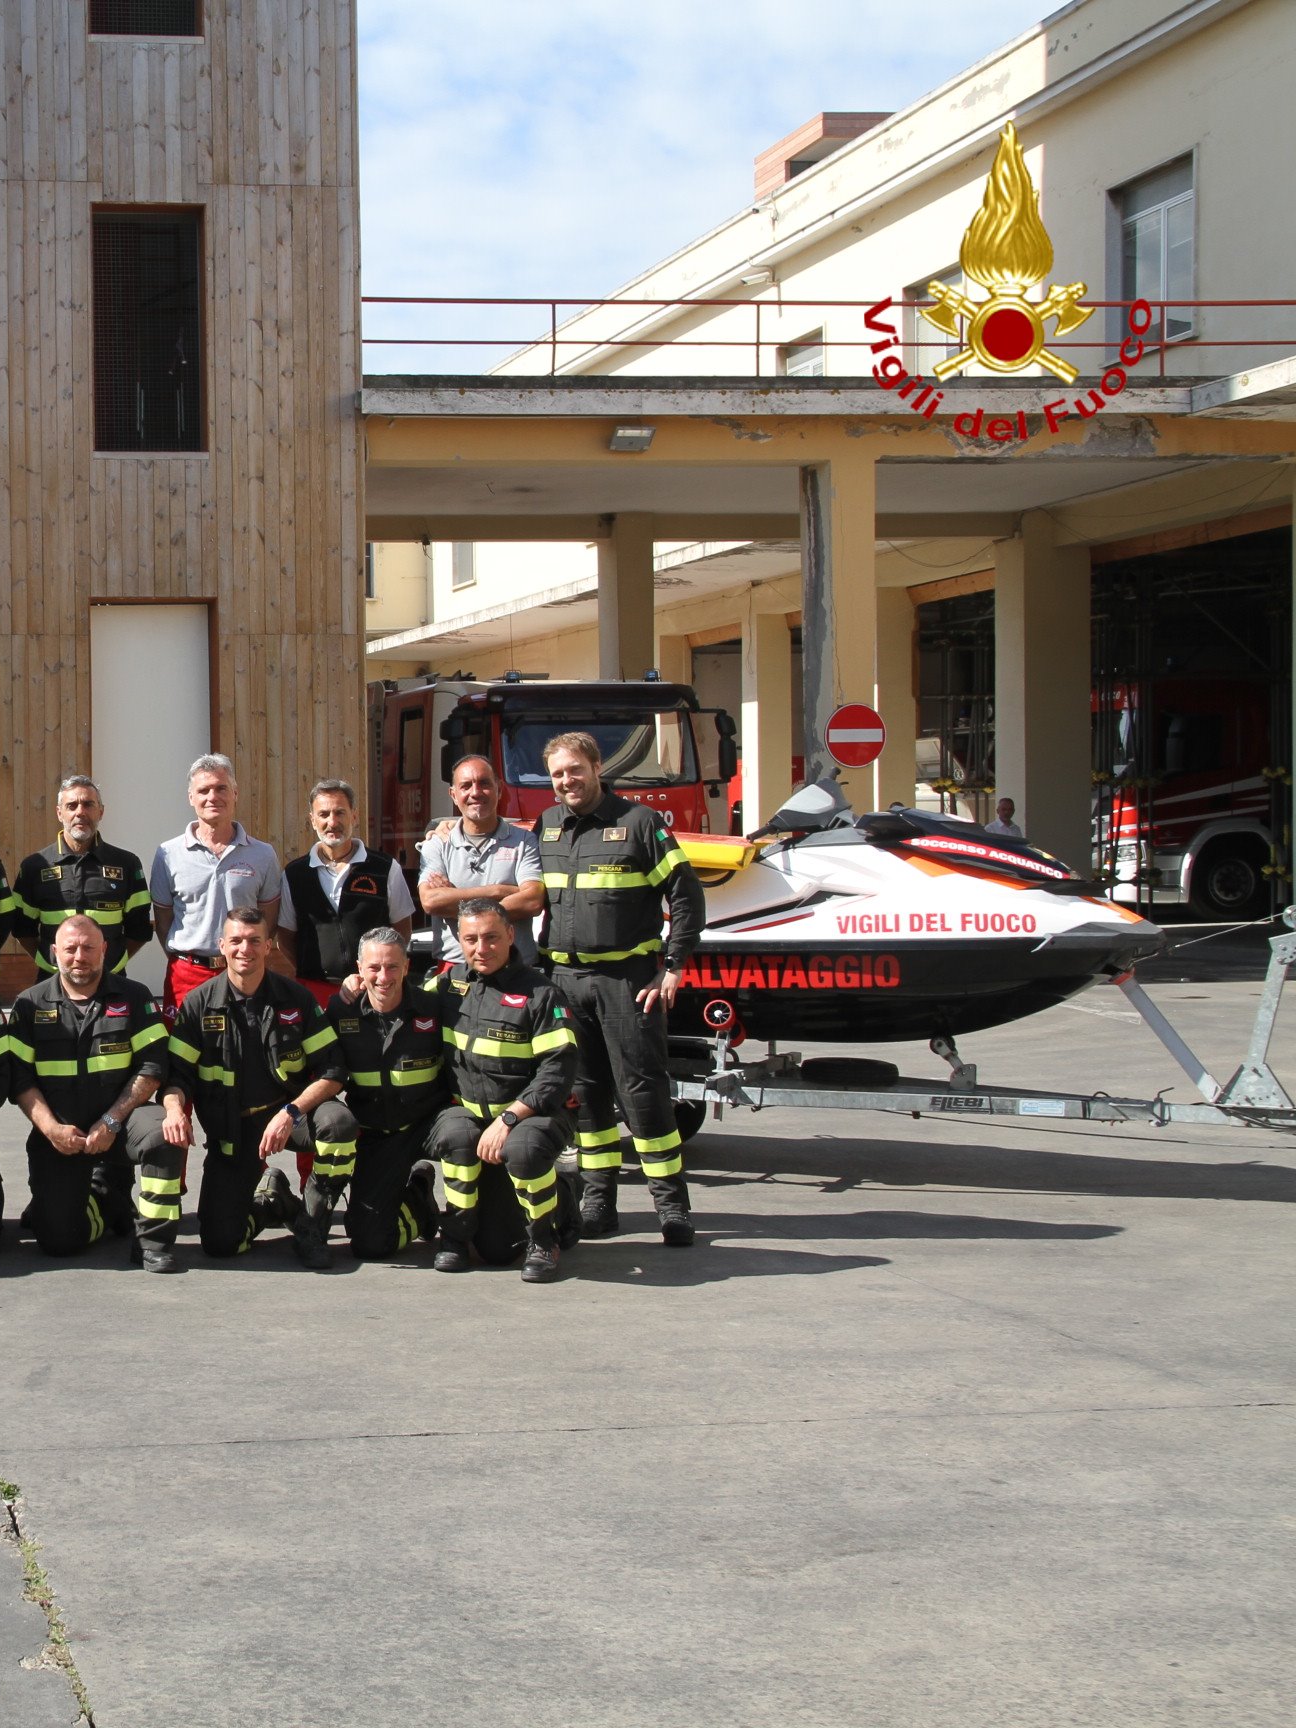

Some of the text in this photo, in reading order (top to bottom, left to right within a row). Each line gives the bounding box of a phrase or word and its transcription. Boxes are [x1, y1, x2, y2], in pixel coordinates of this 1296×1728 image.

[910, 838, 1064, 879] SOCCORSO ACQUATICO
[836, 913, 1036, 934] VIGILI DEL FUOCO
[678, 954, 901, 989] ALVATAGGIO
